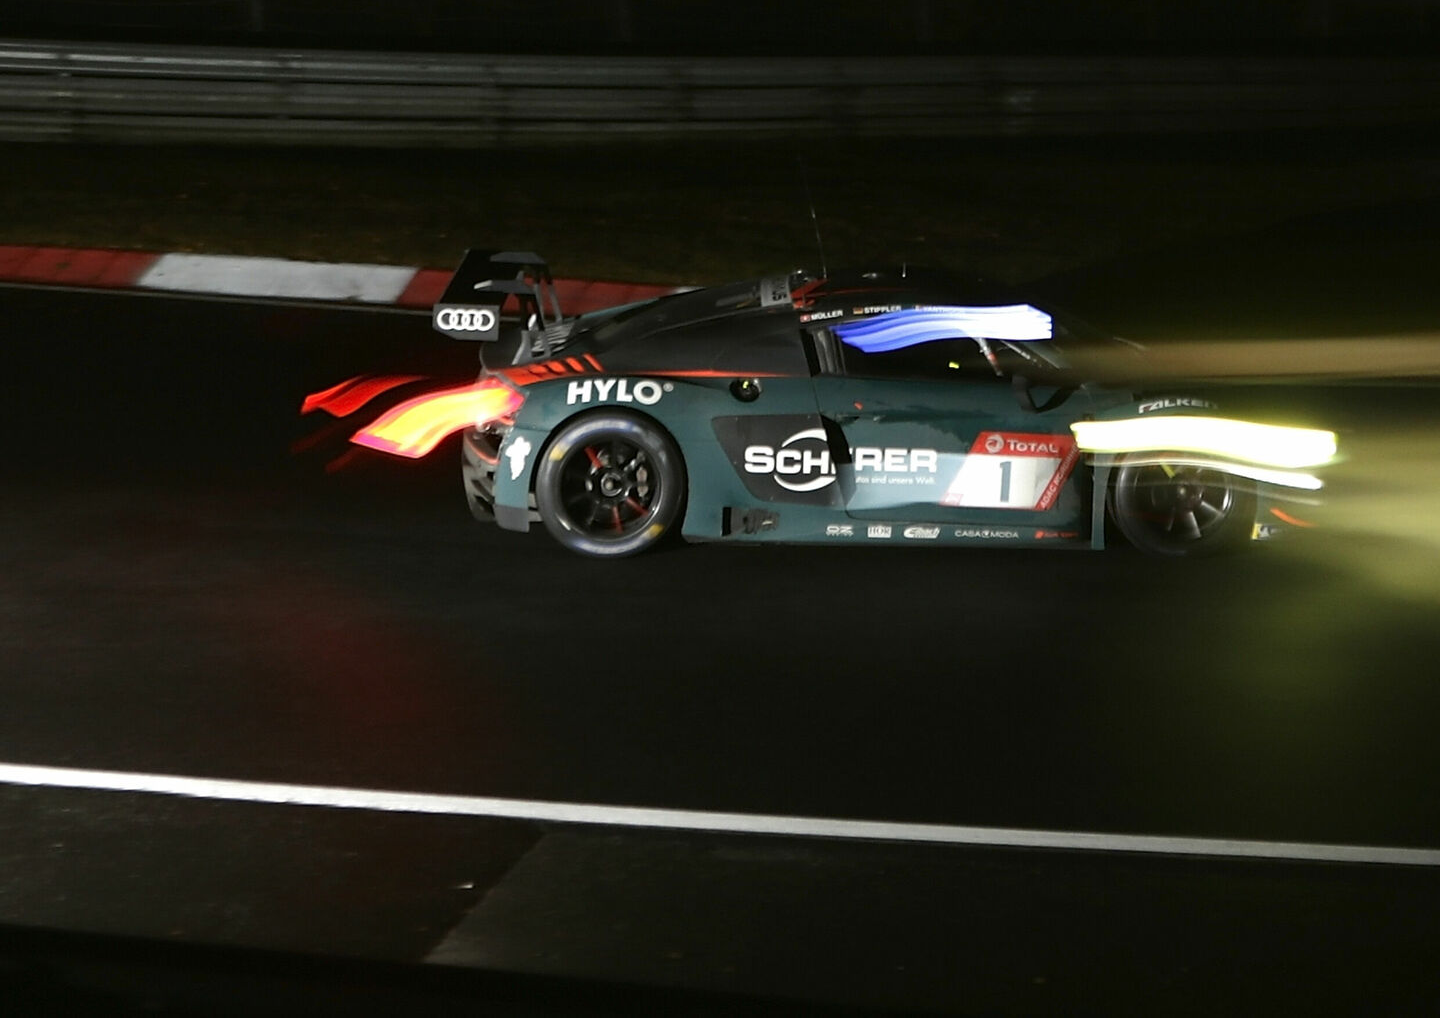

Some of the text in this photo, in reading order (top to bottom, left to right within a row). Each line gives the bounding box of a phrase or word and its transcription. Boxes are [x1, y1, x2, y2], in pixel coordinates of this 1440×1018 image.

[811, 310, 844, 321] MÜLLER
[864, 305, 902, 314] STIPPLER
[1007, 440, 1059, 453] TOTAL
[744, 445, 937, 474] SCHRER
[999, 460, 1012, 503] 1
